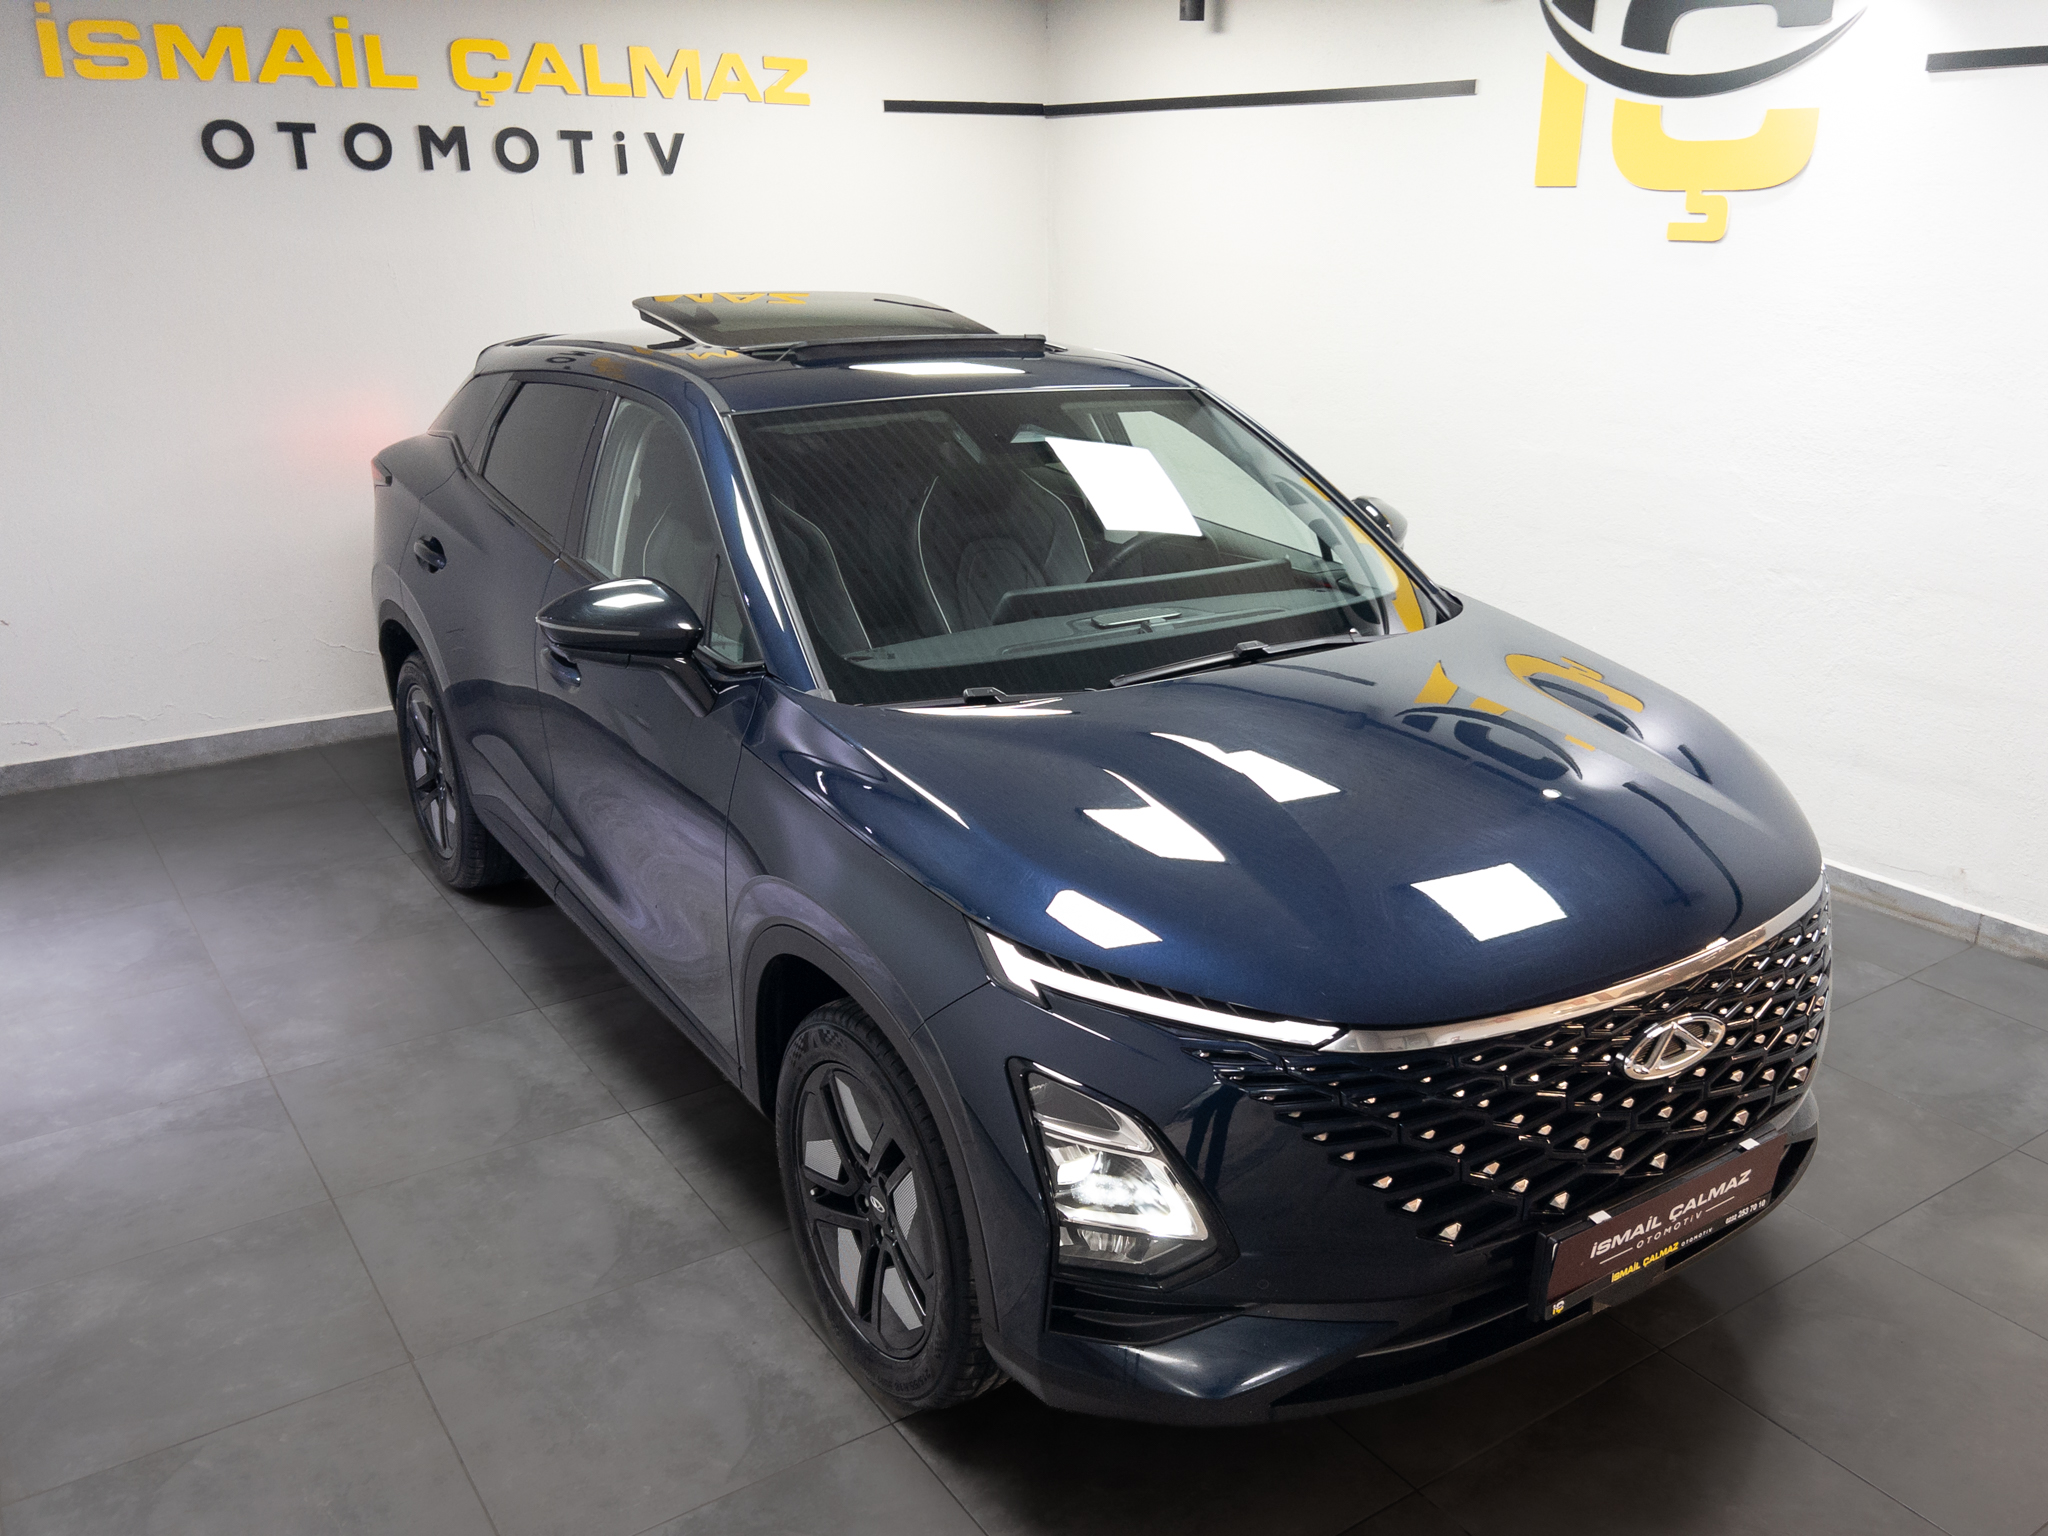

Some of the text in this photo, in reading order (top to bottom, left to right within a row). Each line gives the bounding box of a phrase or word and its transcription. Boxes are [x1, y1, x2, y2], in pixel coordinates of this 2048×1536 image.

[34, 2, 812, 107] İSMAİL ÇALMAZ
[1589, 1168, 1752, 1259] İSMAİL ÇALMAZ
[1611, 1262, 1641, 1283] İSMAİL
[1642, 1241, 1679, 1268] ÇALMAZ
